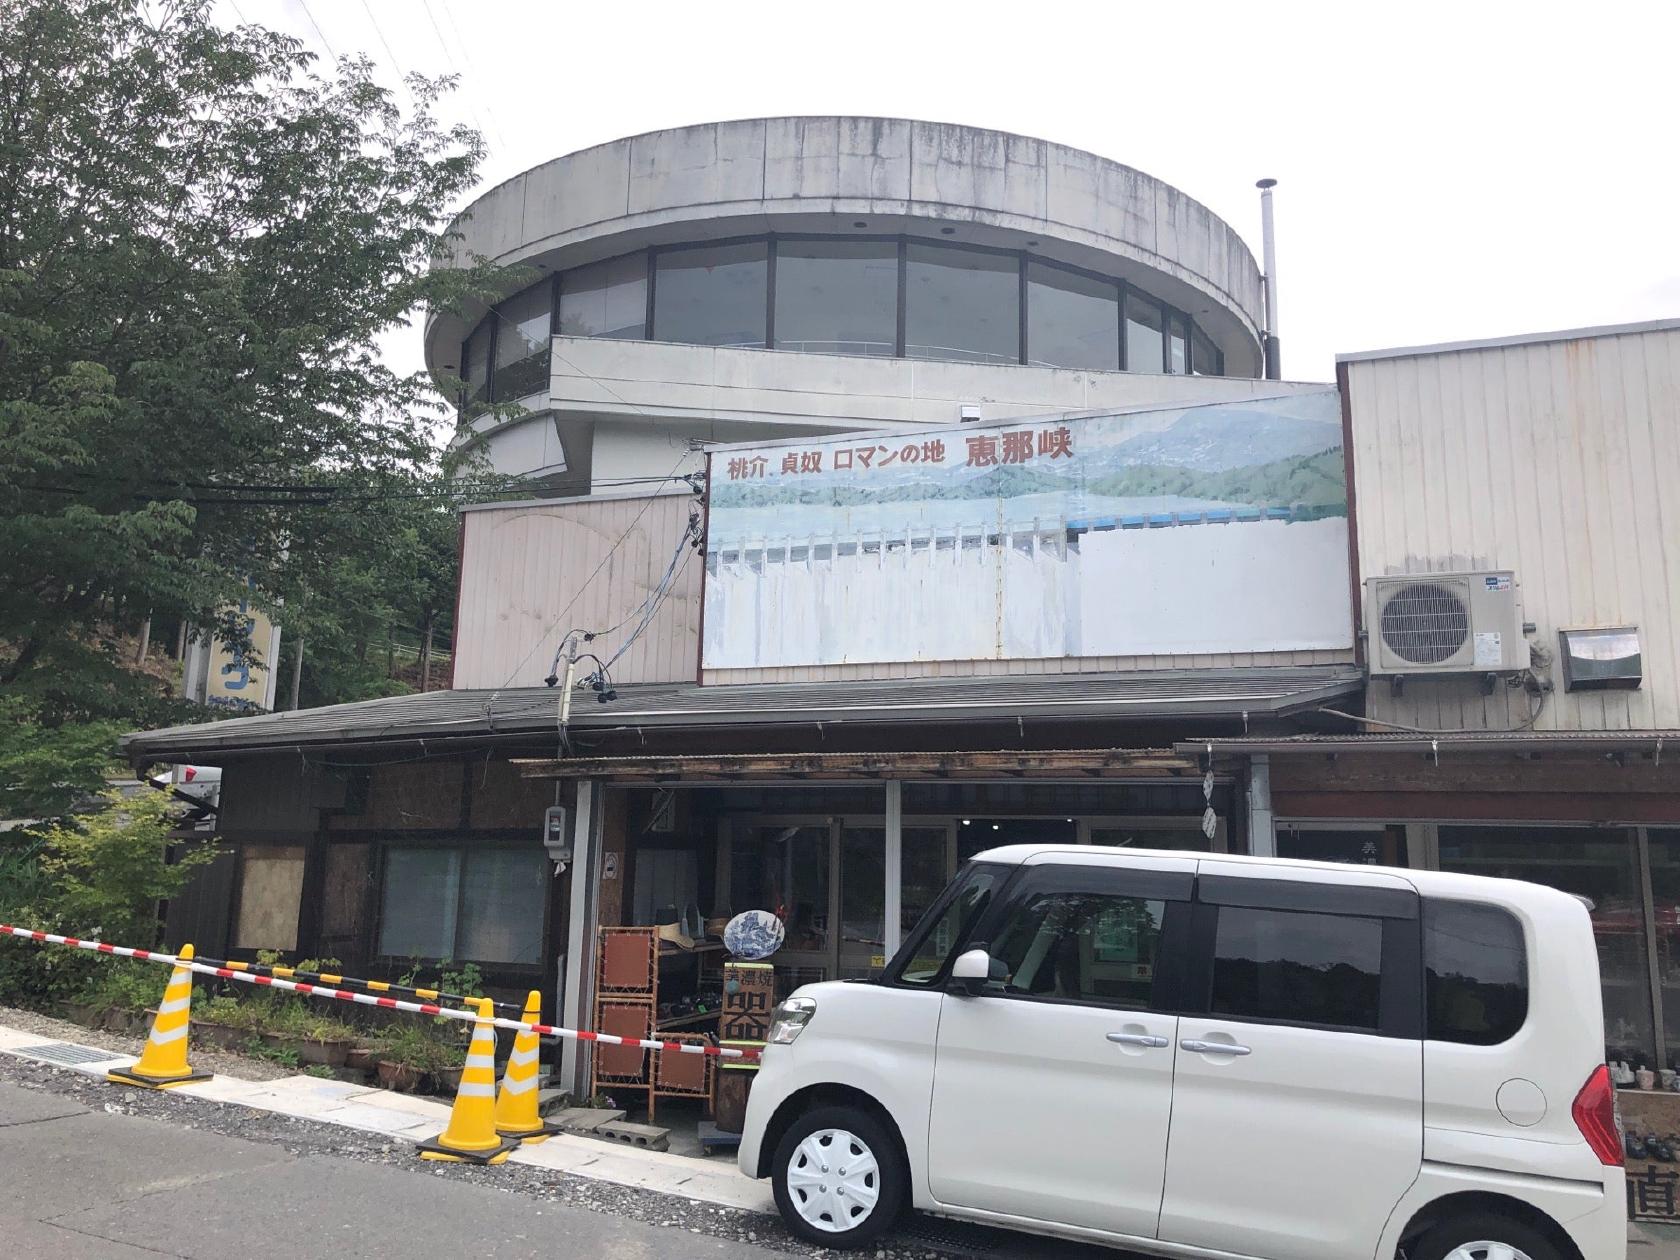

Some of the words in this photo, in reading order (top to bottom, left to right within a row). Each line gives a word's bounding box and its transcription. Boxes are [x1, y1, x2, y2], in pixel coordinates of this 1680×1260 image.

[834, 439, 946, 470] ロマンの地
[965, 426, 1074, 468] 恵那峡
